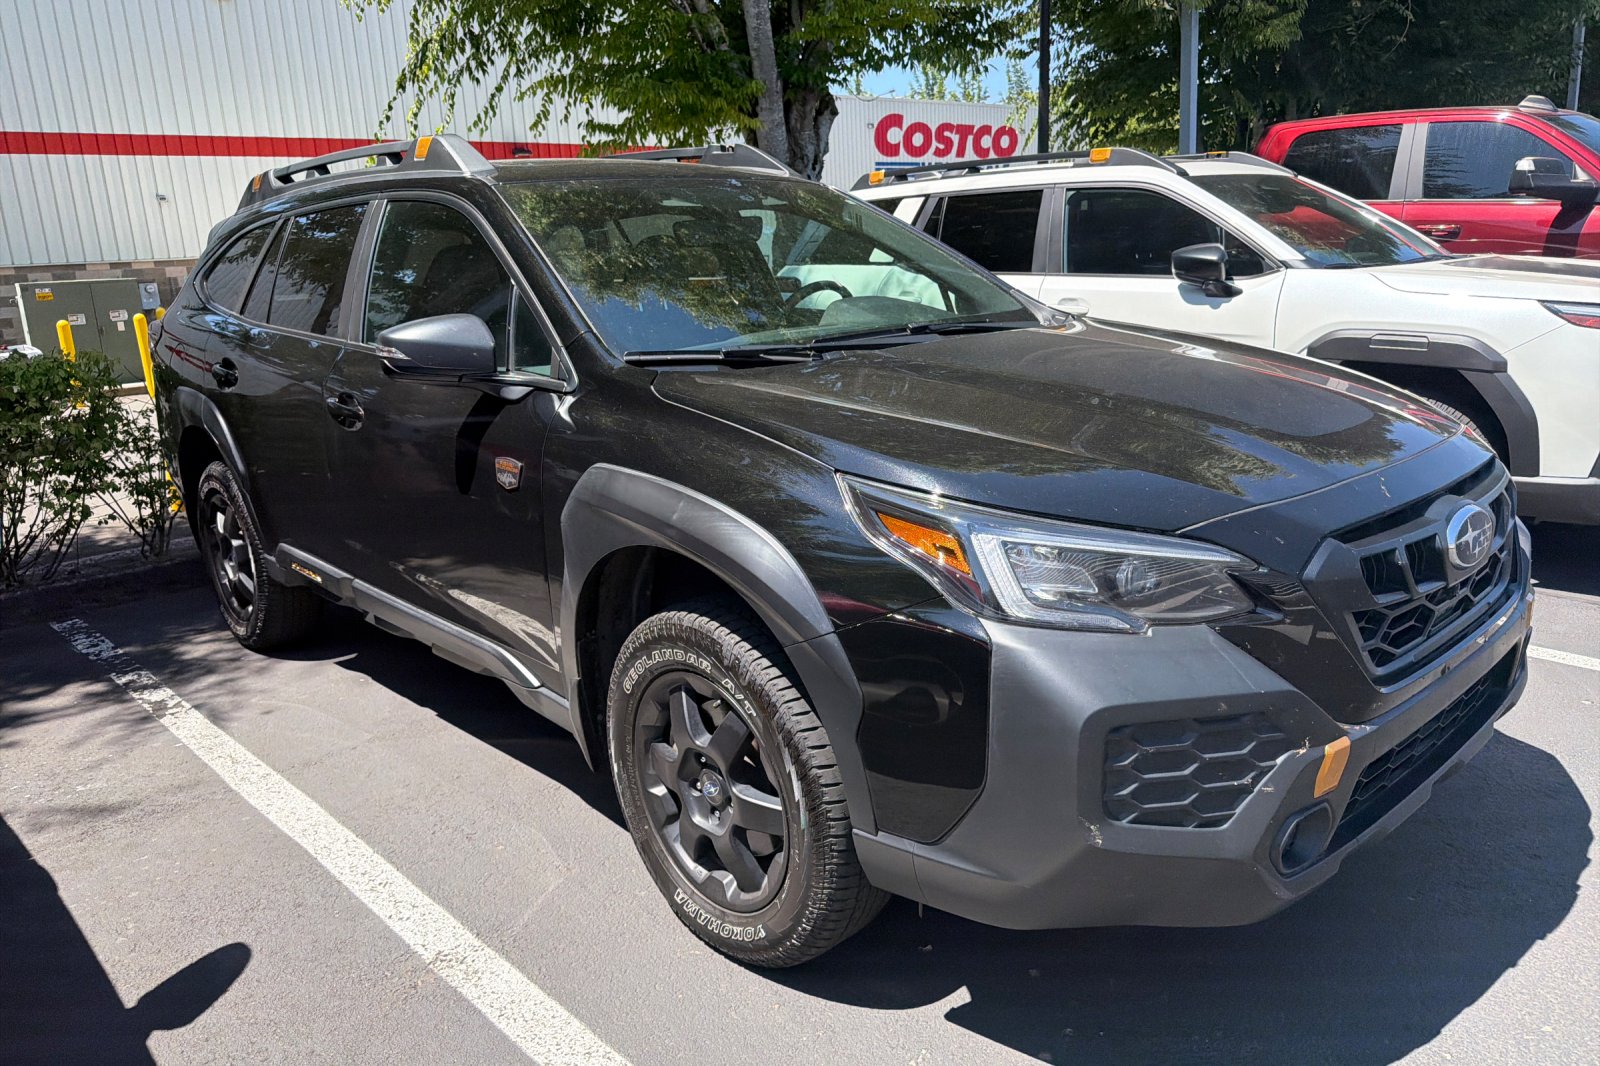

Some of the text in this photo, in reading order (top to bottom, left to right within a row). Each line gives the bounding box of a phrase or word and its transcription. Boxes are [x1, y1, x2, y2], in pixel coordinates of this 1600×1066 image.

[874, 113, 1018, 159] COSTCO
[623, 649, 756, 717] GEOLANDAR A/T
[674, 888, 766, 941] YOKOHAMA
